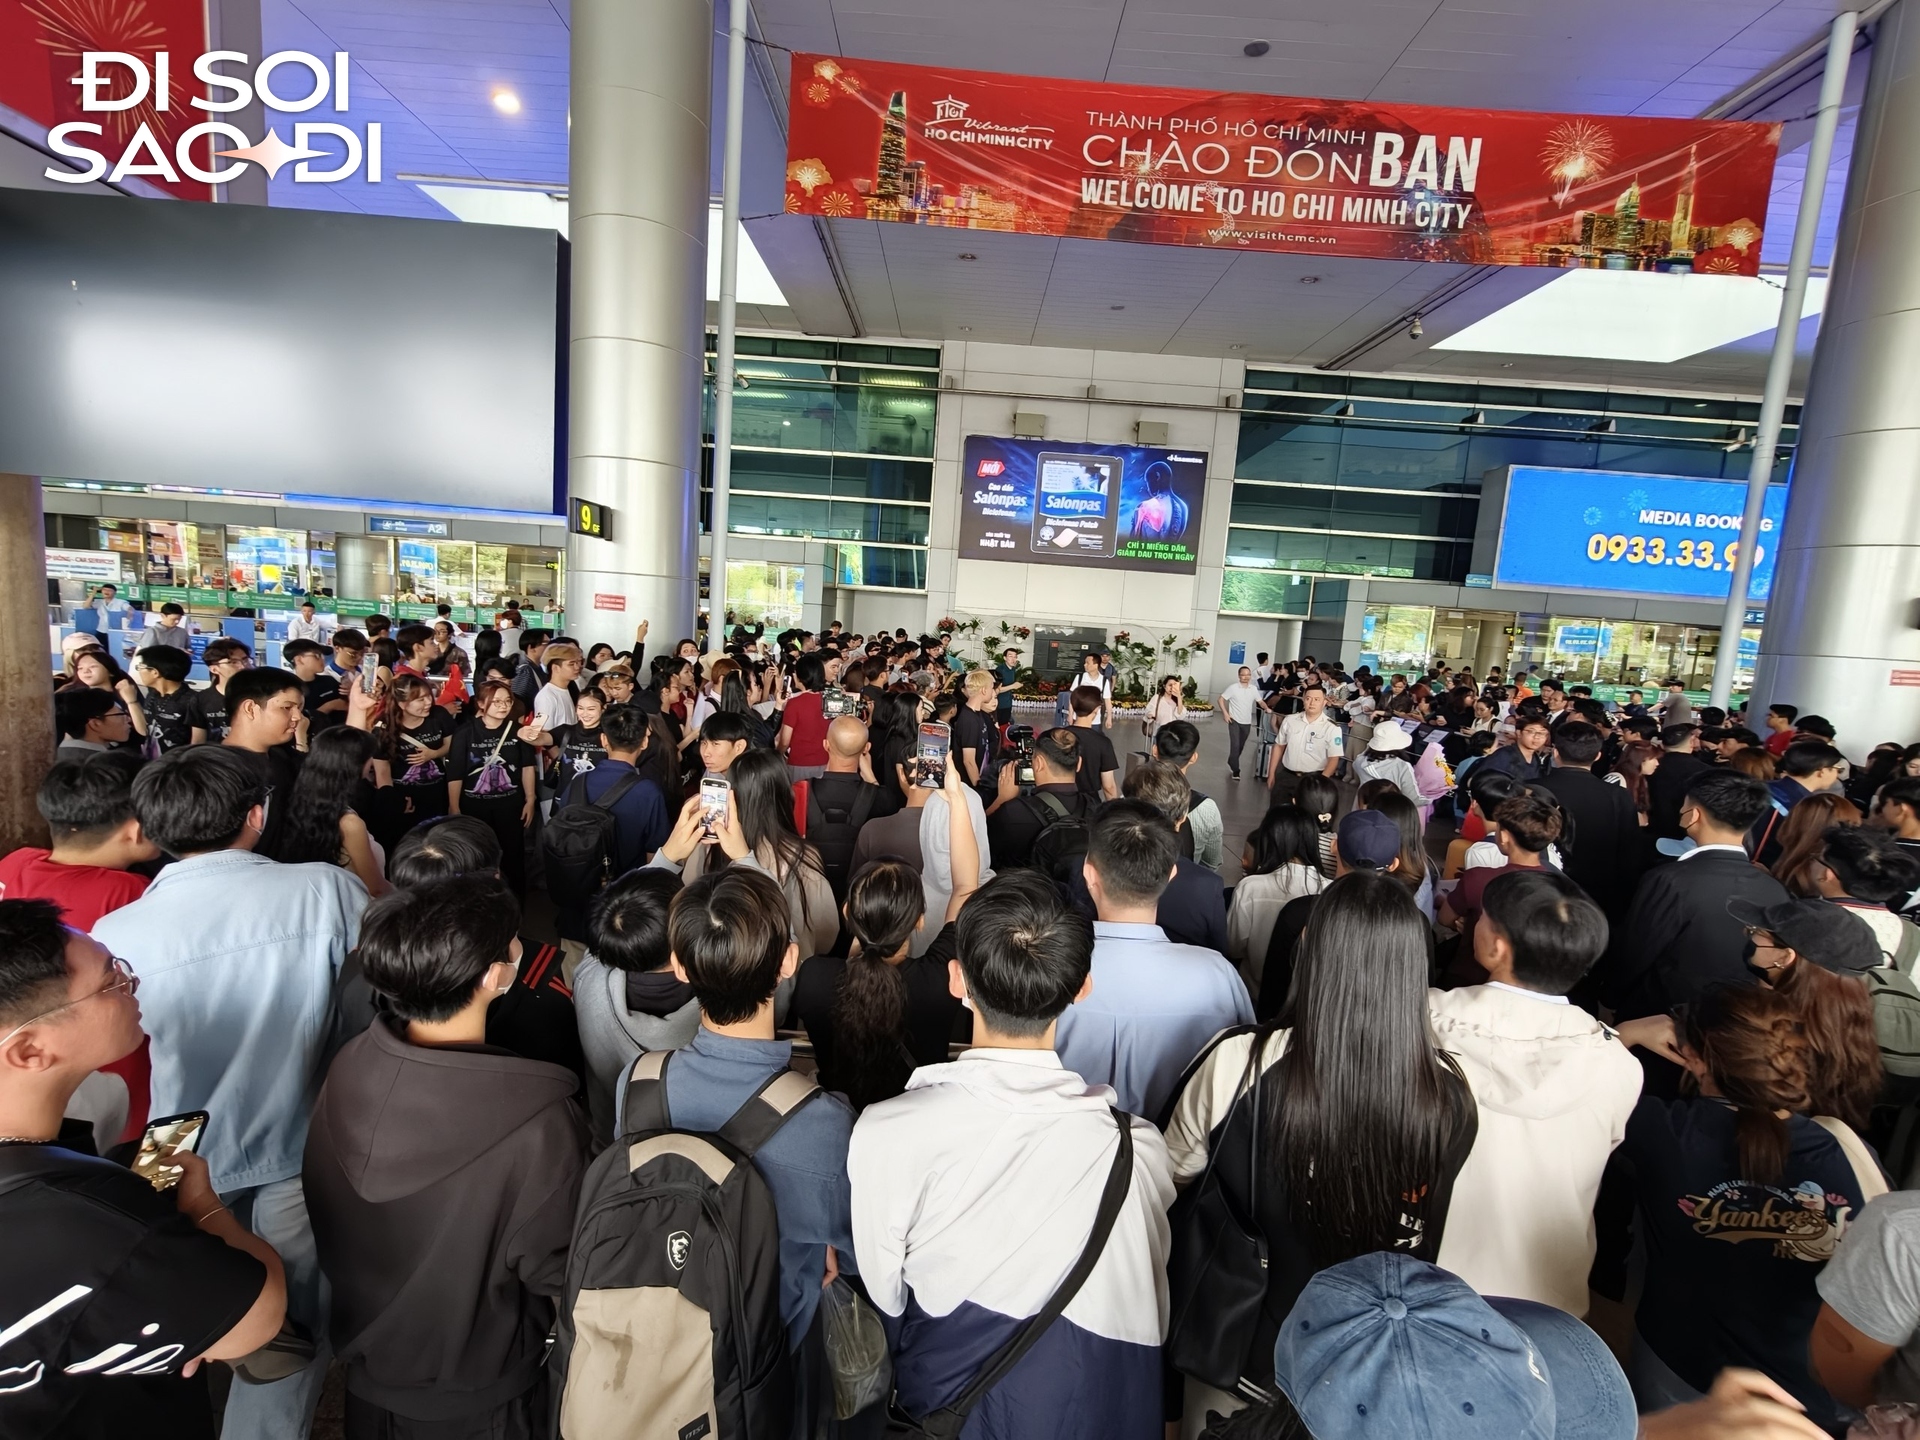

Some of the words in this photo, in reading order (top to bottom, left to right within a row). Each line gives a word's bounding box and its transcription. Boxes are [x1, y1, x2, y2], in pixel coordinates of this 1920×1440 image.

[964, 118, 1034, 134] Vibrant
[1086, 110, 1163, 131] THÀNH
[1169, 116, 1218, 135] PHỐ
[1224, 118, 1258, 138] HỒ
[1263, 123, 1302, 141] CHÍ
[1307, 127, 1366, 145] MINH
[924, 128, 948, 141] HO
[949, 130, 976, 144] CHI
[977, 133, 1015, 148] MINH
[1016, 137, 1053, 151] CITY
[1082, 132, 1230, 175] CHÀO
[1244, 142, 1362, 185] ĐÓN
[1369, 131, 1483, 200] BẠN
[1081, 177, 1205, 213] WELCOME
[1213, 187, 1245, 215] TO
[1251, 190, 1286, 218] HO
[1292, 193, 1335, 221] CHI
[1341, 196, 1408, 226] MINH
[1415, 202, 1472, 229] CITY
[1207, 228, 1337, 245] www.visithcmc.vn
[981, 460, 1001, 475] MỚI
[973, 490, 1028, 508] Salonpas
[1045, 495, 1102, 513] Salonpas
[581, 505, 591, 531] 9
[1639, 509, 1692, 527] MEDIA
[1694, 514, 1773, 532] BOOKG
[427, 523, 443, 534] A2
[231, 592, 250, 600] Grab
[317, 597, 335, 606] Grab
[1596, 685, 1614, 694] Grab
[1686, 1195, 1826, 1235] Yankees
